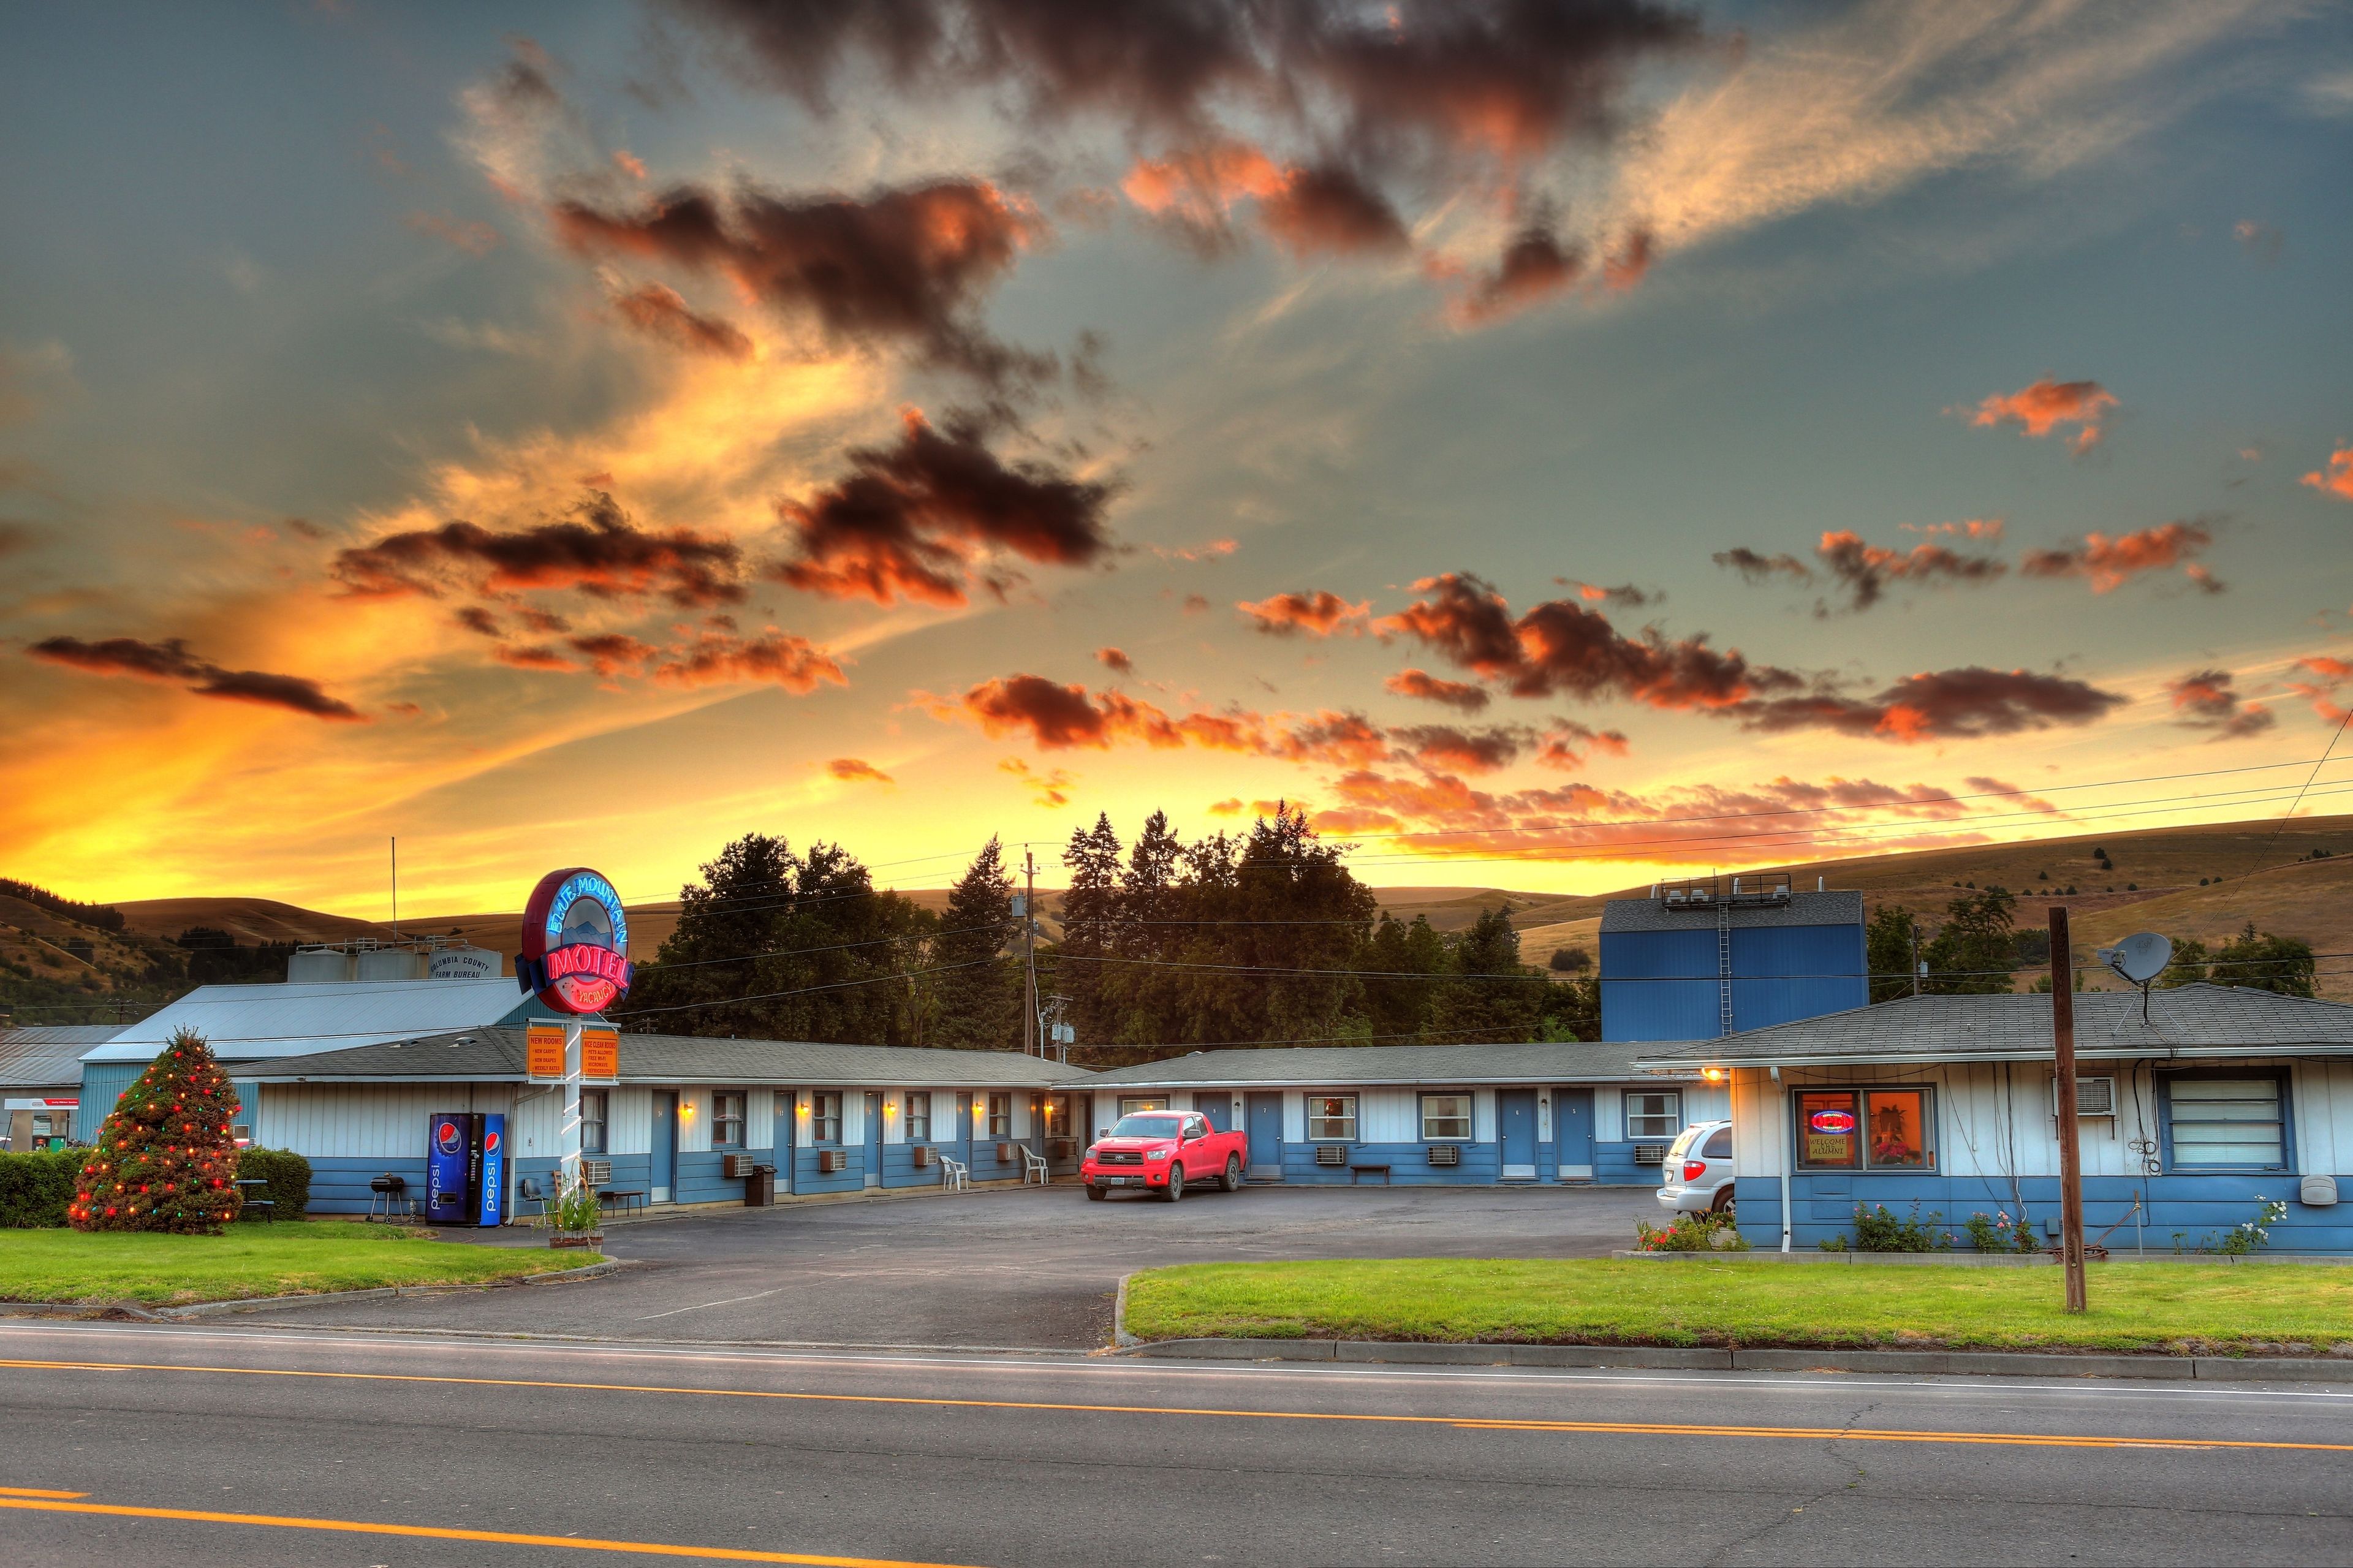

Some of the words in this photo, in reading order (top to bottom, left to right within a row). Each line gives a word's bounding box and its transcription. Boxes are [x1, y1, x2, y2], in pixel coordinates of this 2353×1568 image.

[547, 885, 576, 935] BLUE
[576, 877, 628, 943] MOUNTAIN
[431, 956, 458, 972] COLUMBIA
[463, 957, 489, 971] COUNTY
[548, 944, 629, 988] MOTEL
[578, 984, 612, 1004] VACANCY
[1811, 1116, 1854, 1128] OPEN
[431, 1164, 441, 1210] pepsi
[487, 1162, 497, 1211] pepsi
